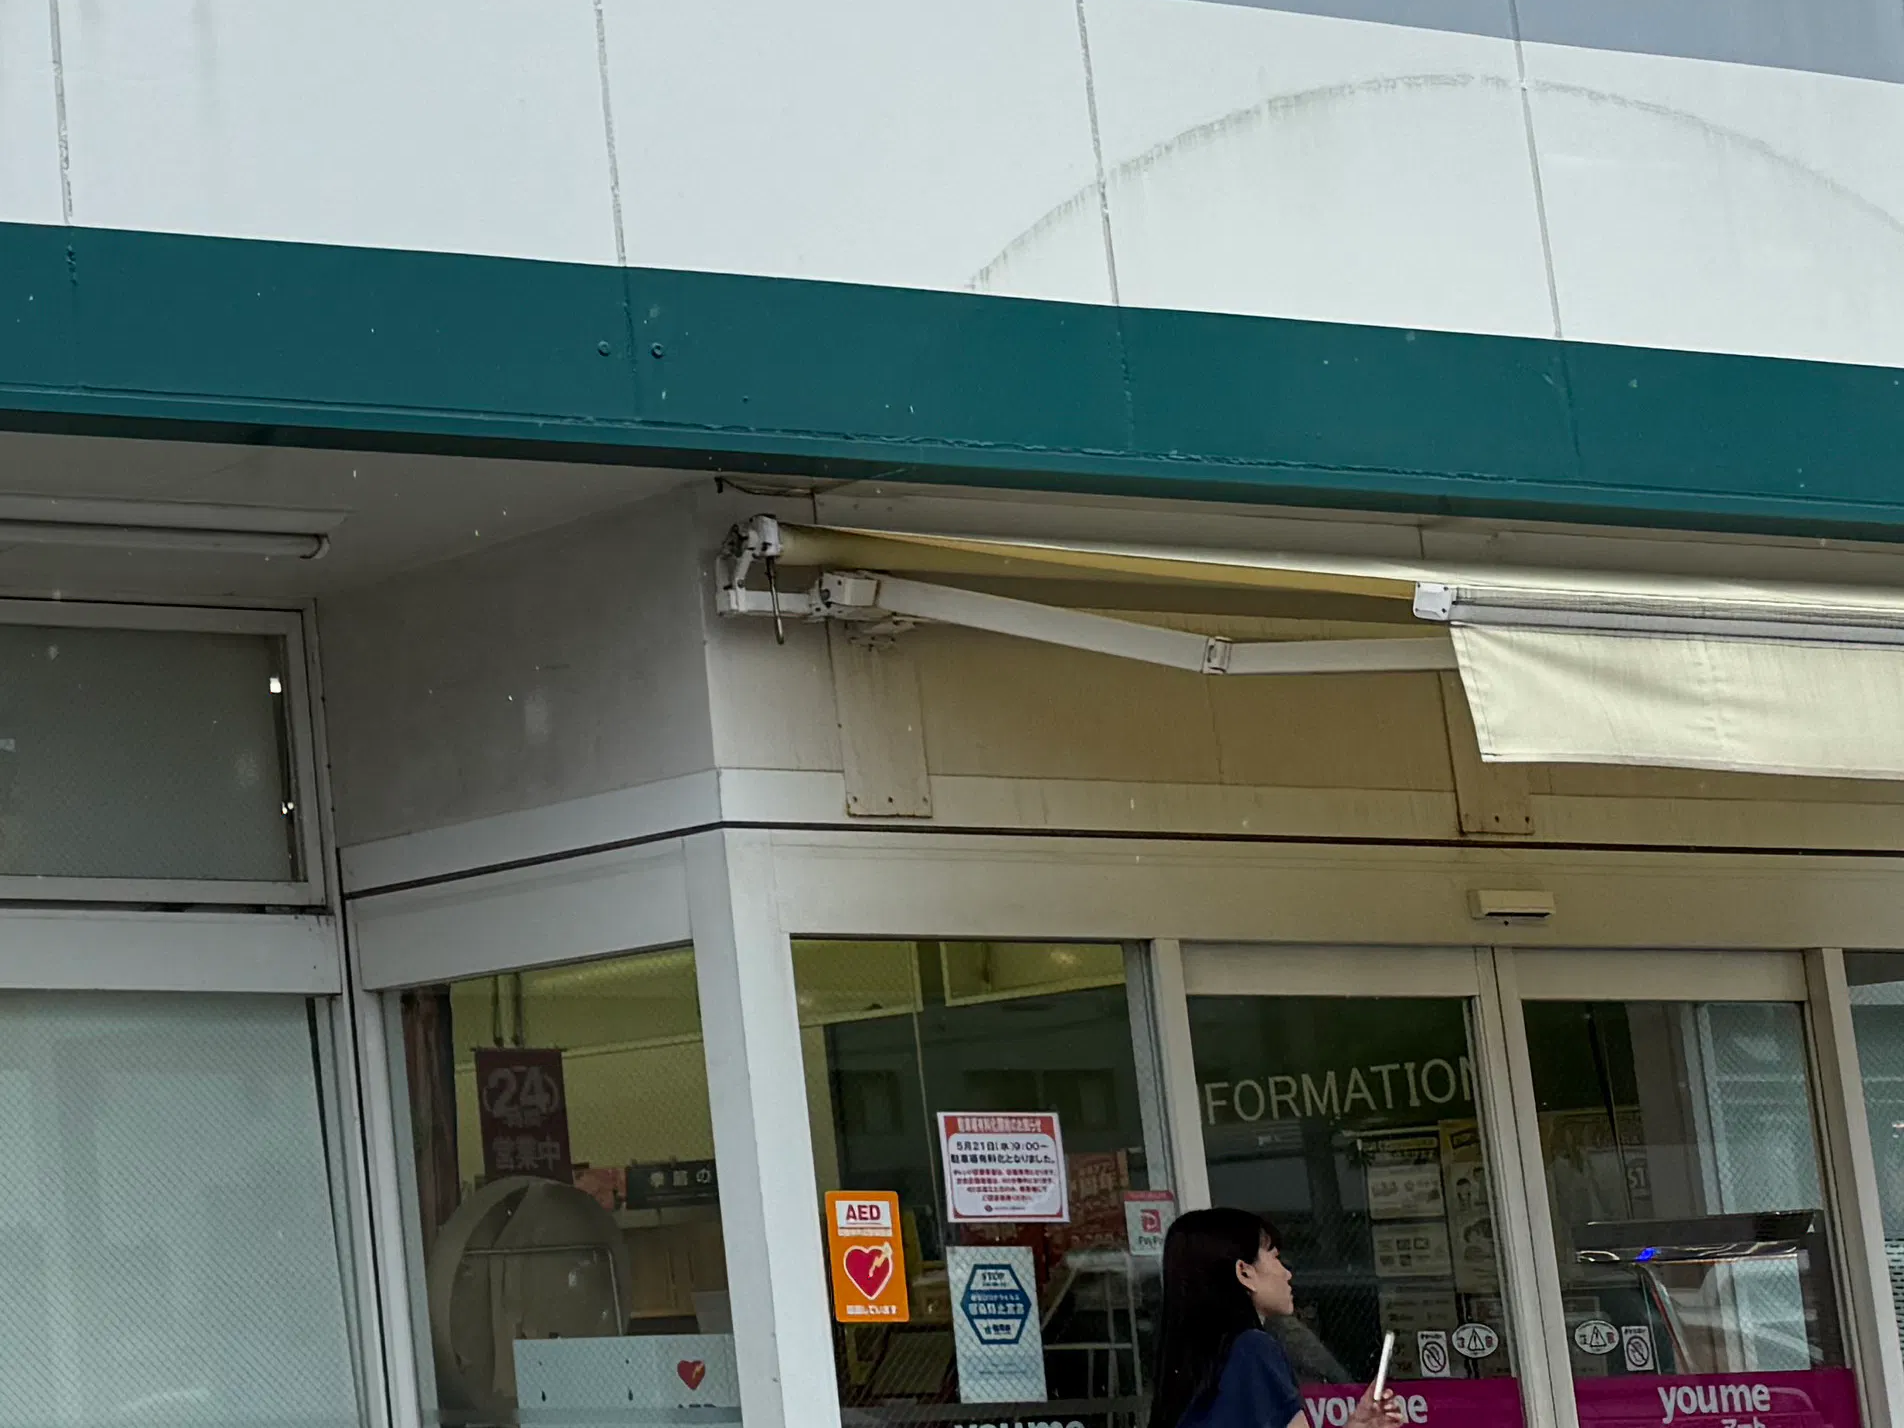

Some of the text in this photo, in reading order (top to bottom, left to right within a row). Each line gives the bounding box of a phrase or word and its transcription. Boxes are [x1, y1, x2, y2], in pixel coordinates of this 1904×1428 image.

[487, 1066, 550, 1115] 24
[493, 1133, 561, 1171] 営業中
[845, 1203, 882, 1221] AED
[1657, 1380, 1771, 1424] youme
